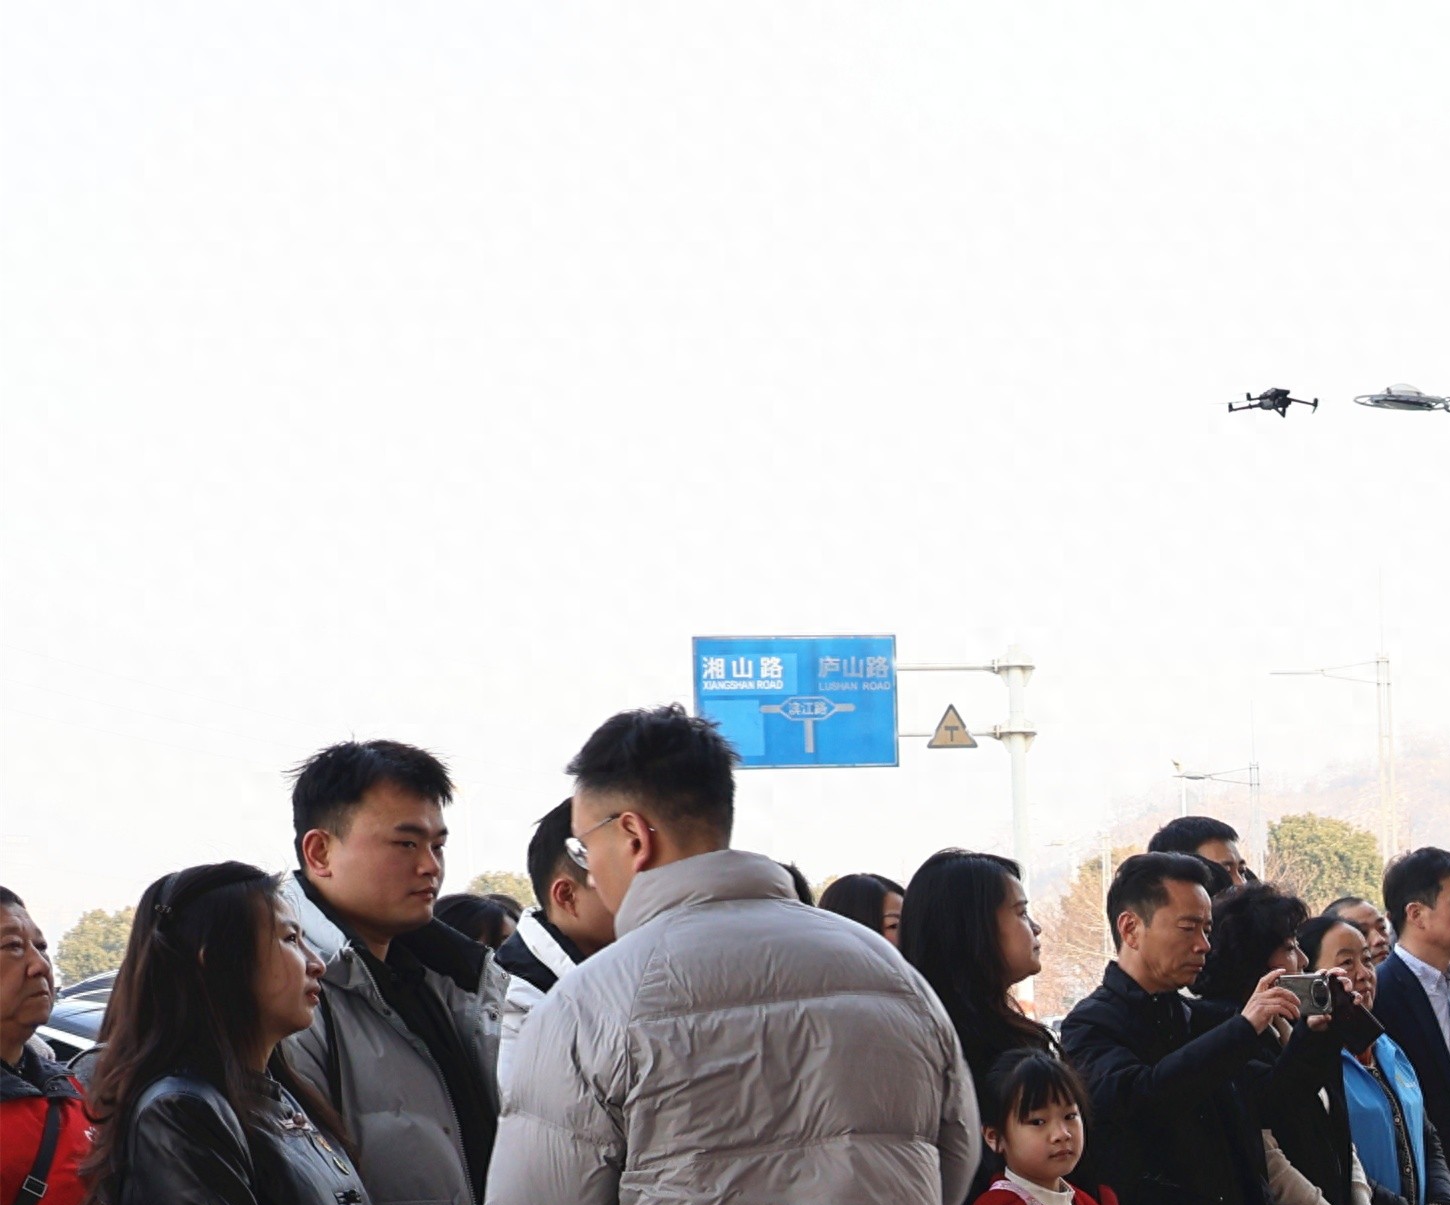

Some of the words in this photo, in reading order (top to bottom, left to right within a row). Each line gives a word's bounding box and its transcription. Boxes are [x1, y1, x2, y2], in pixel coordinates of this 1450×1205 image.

[703, 656, 783, 679] 湘山路
[818, 656, 889, 678] 庐山路
[703, 680, 755, 690] XIANGSHAN
[757, 680, 783, 690] ROAD
[819, 682, 858, 691] LUSHAN
[863, 681, 890, 690] ROAD
